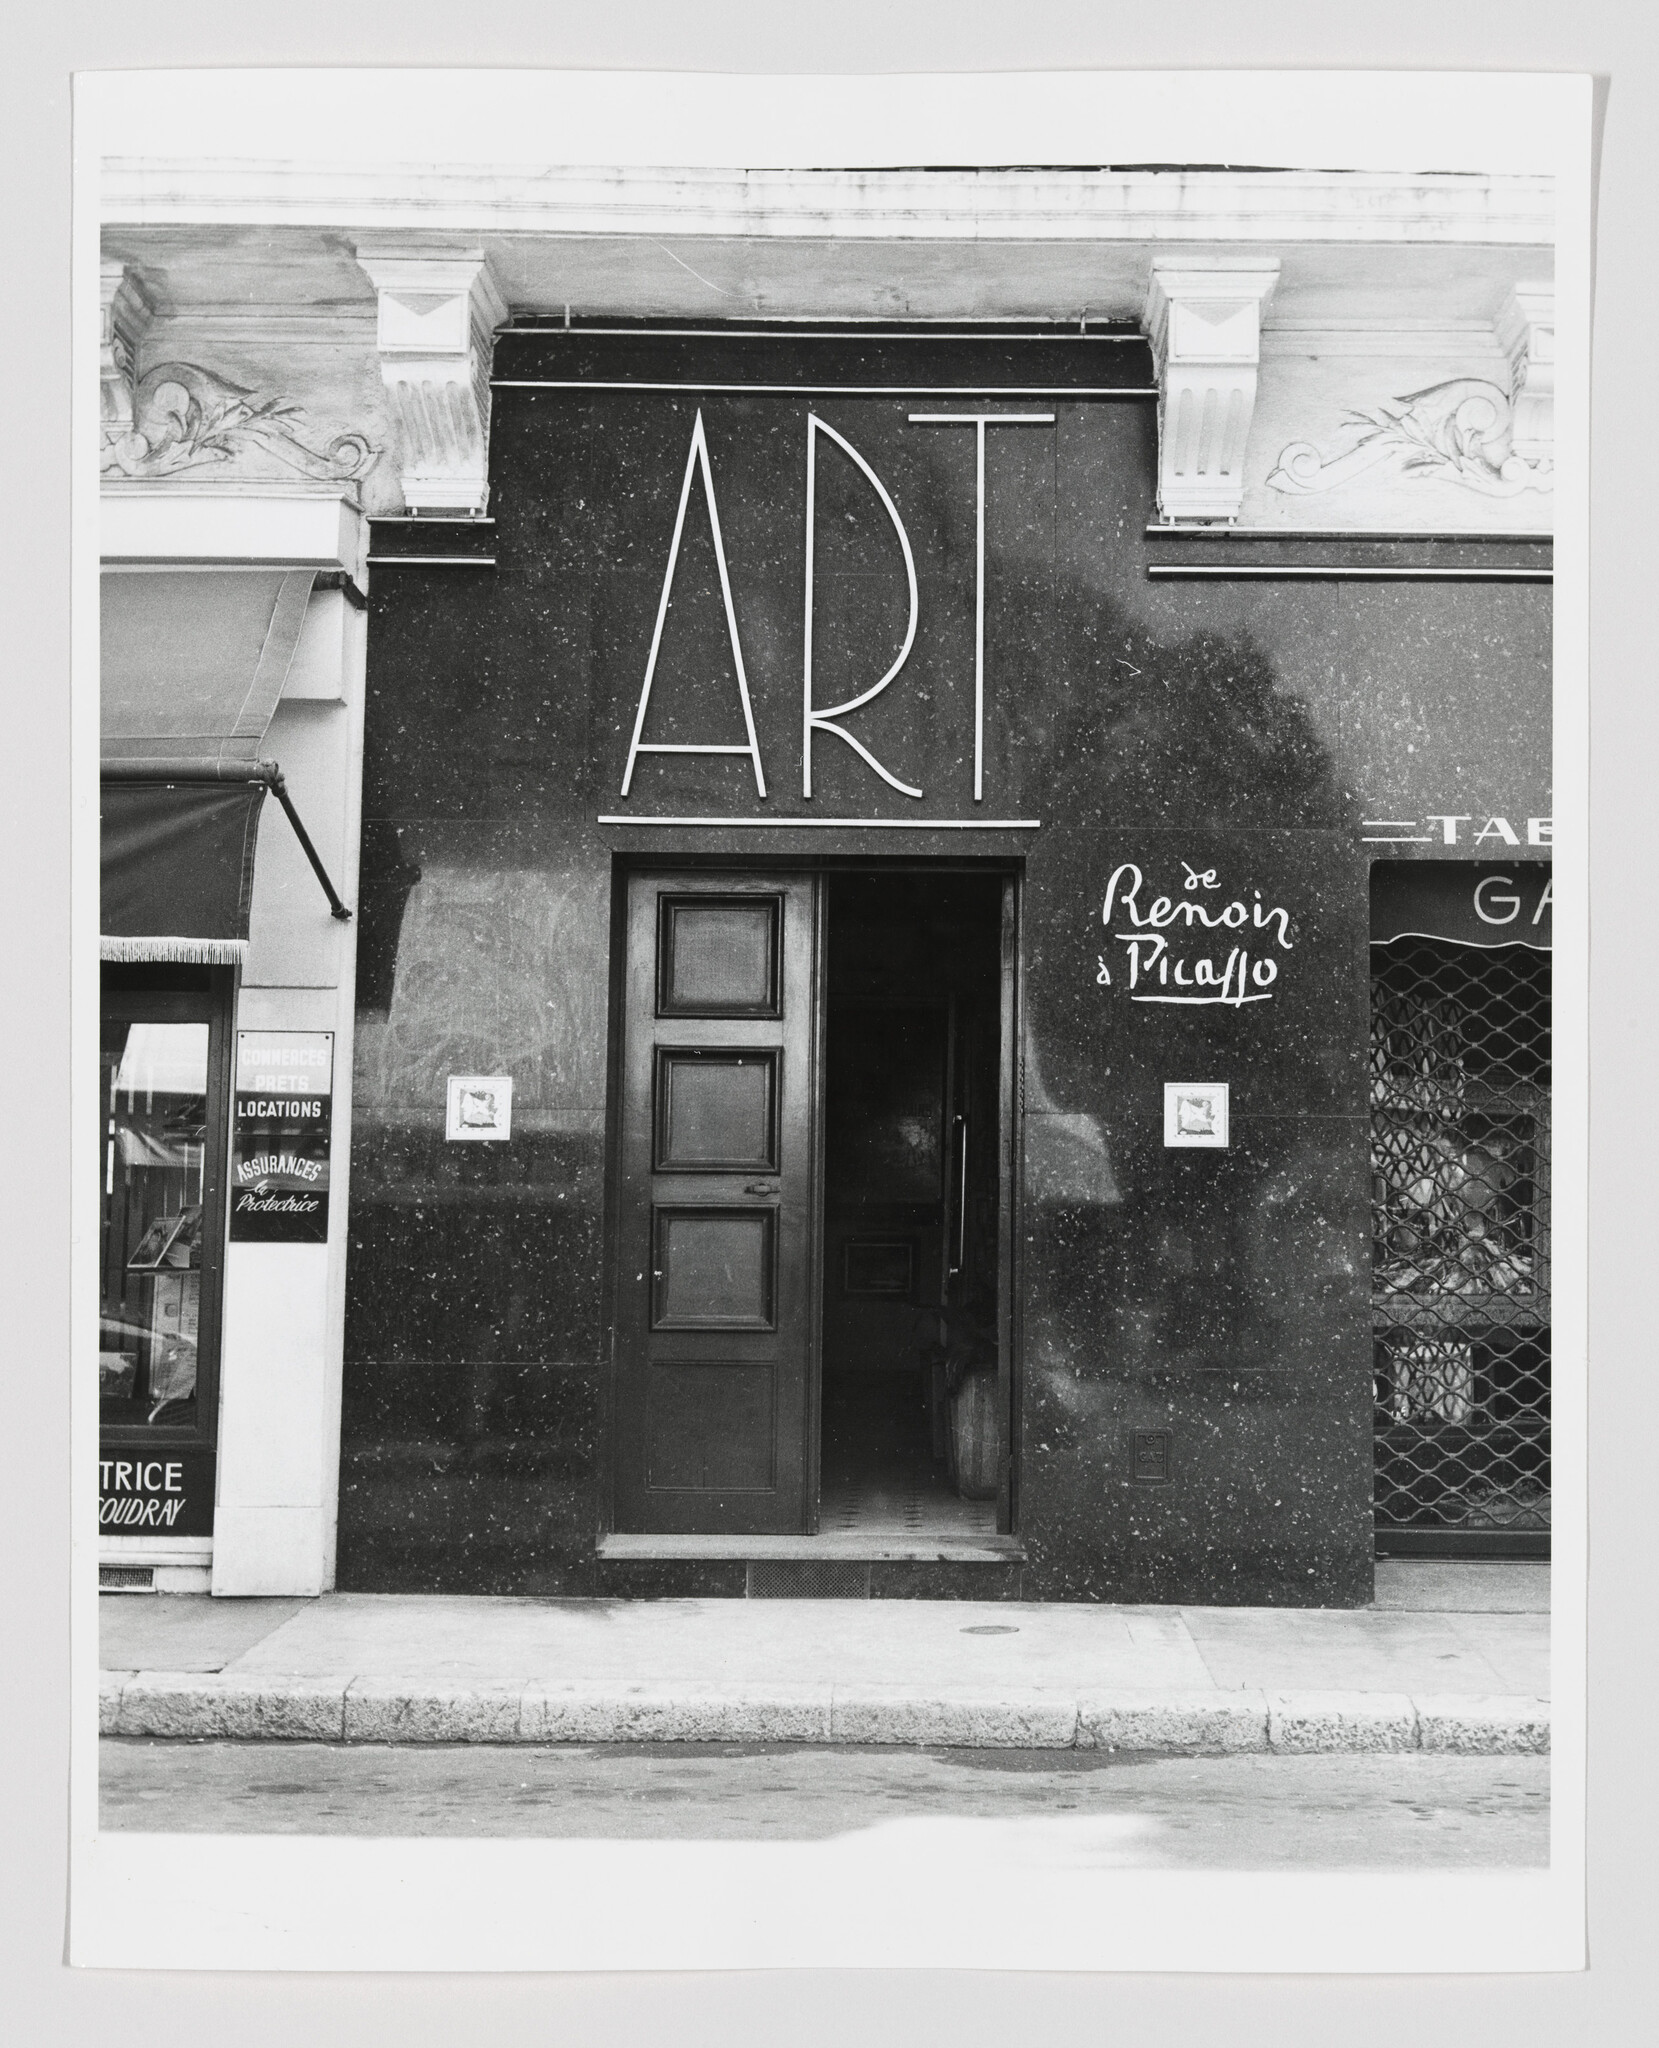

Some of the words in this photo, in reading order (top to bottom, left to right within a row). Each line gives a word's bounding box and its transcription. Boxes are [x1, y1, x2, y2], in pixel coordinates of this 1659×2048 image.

[620, 408, 1055, 801] ART
[1181, 861, 1221, 890] de
[1103, 863, 1293, 949] Renoir
[241, 1049, 327, 1067] COMMERCES
[255, 1075, 310, 1092] PRETS
[237, 1100, 322, 1118] LOCATIONS
[236, 1155, 322, 1183] ASSURANCES
[235, 1193, 319, 1212] Protectrice
[99, 1461, 183, 1492] TRICE
